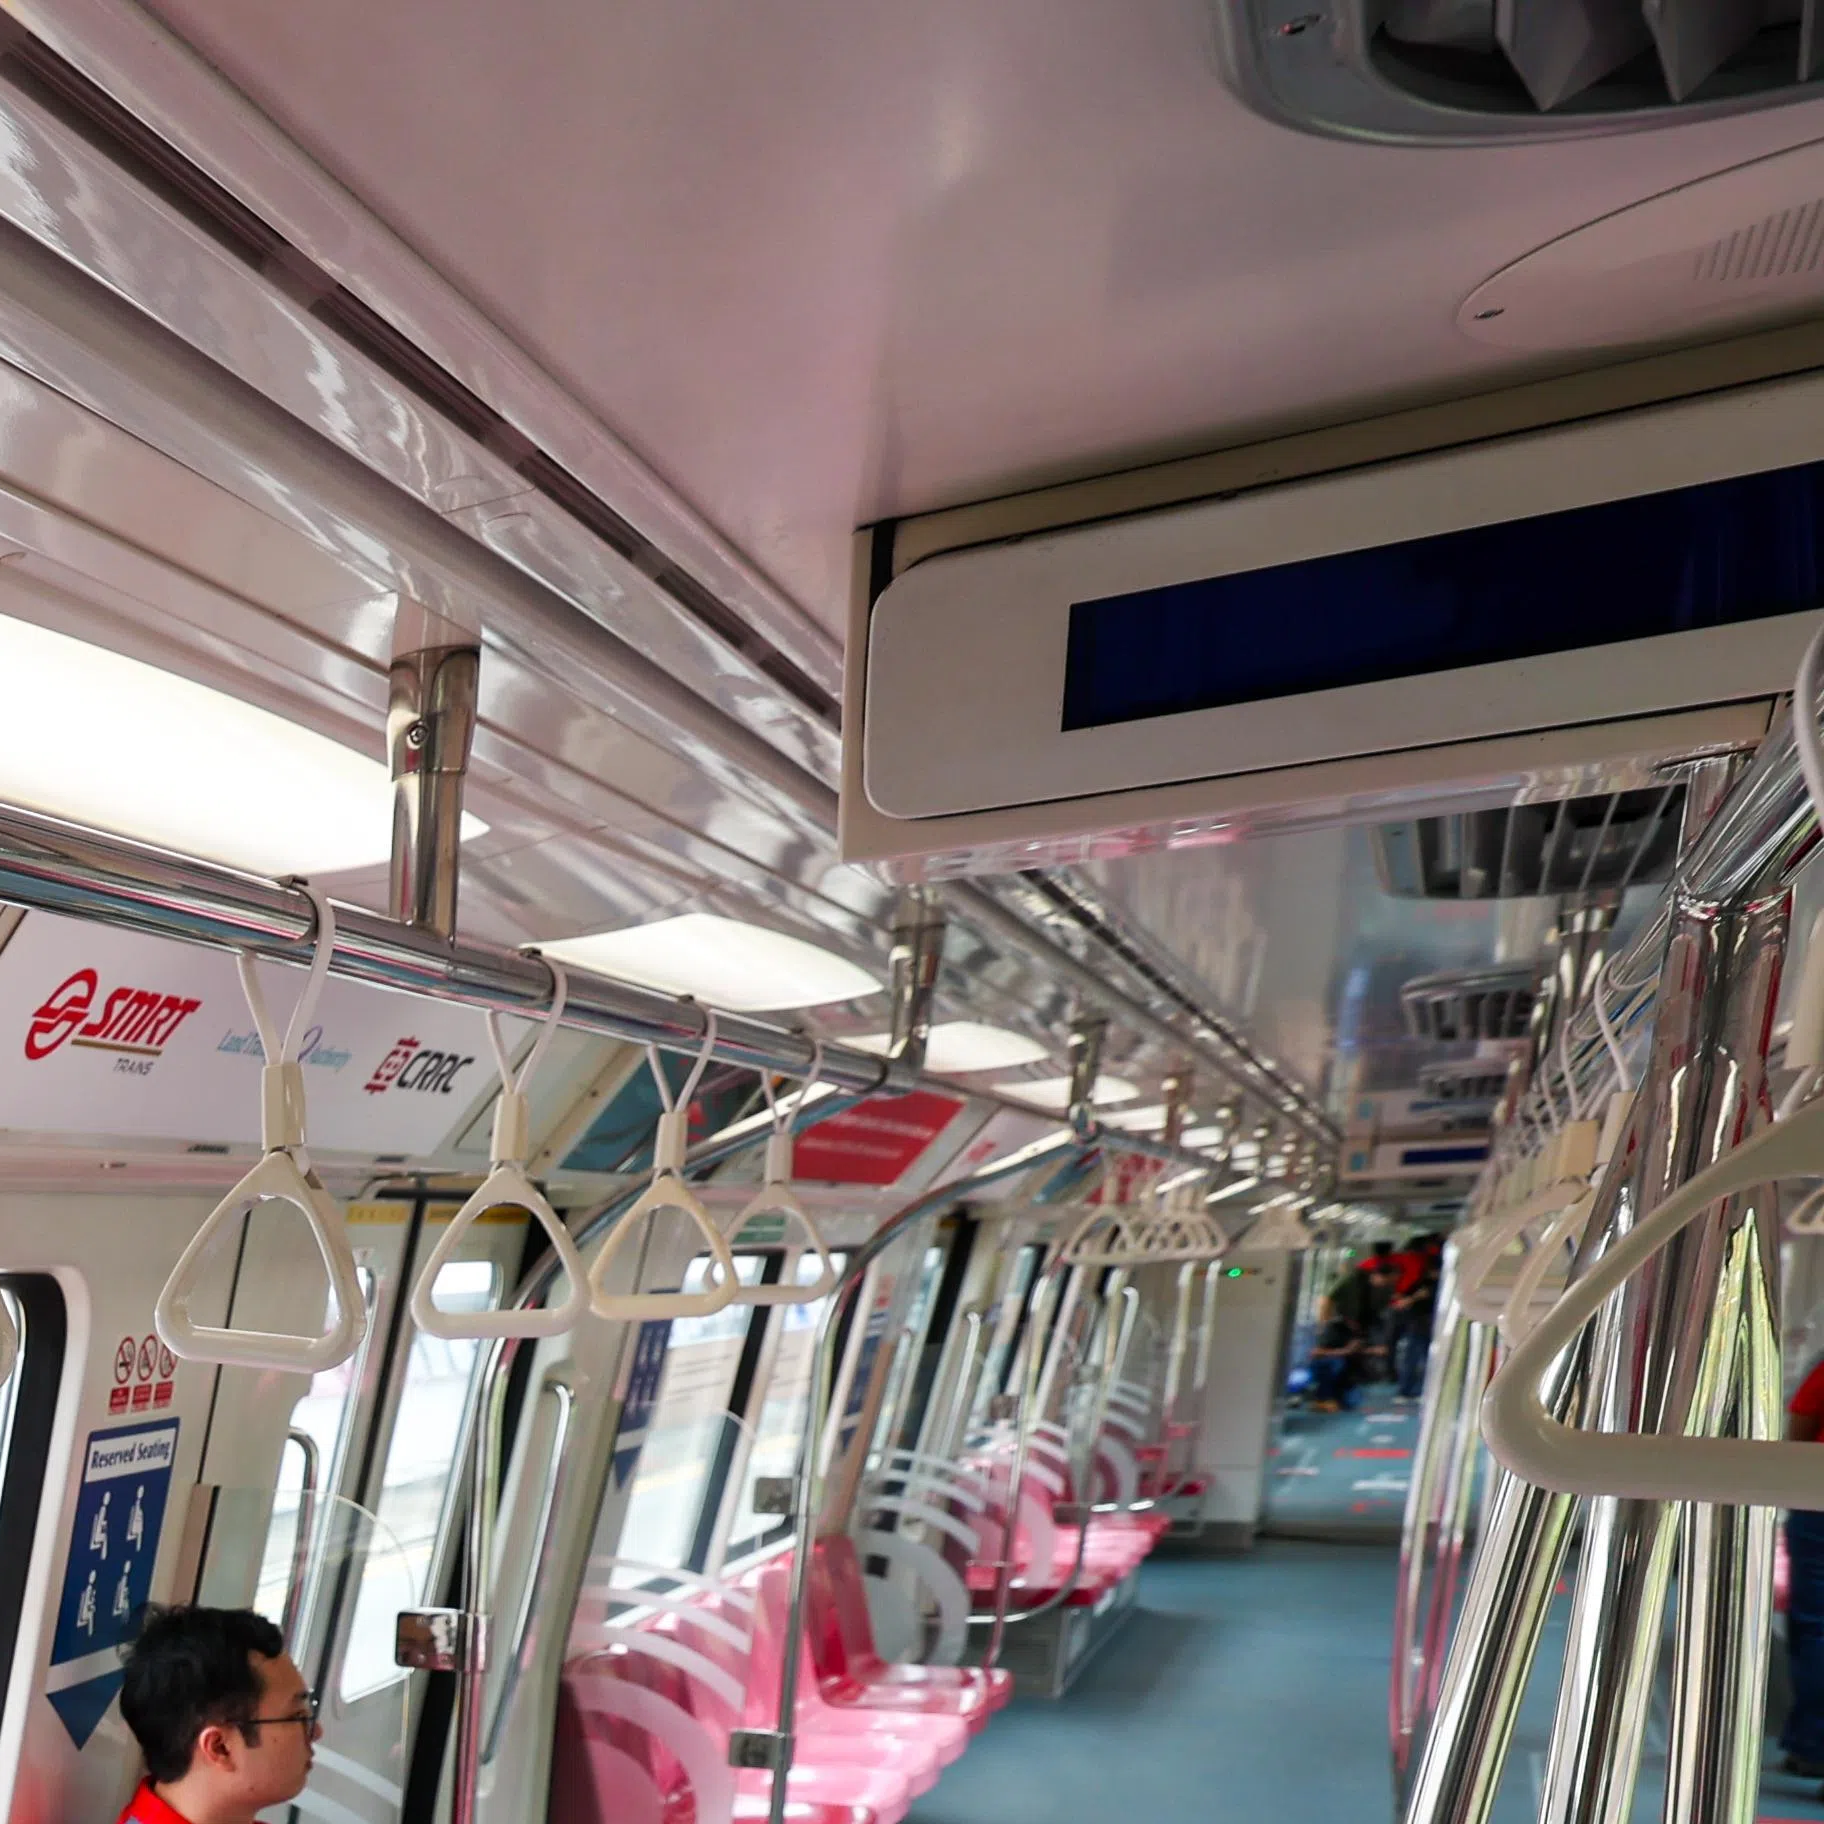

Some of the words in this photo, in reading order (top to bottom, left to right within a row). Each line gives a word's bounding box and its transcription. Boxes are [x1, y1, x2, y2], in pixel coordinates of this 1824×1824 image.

[78, 986, 203, 1046] SMRT
[396, 1048, 475, 1094] CRRC
[91, 1441, 136, 1469] Reserved
[138, 1438, 170, 1462] Seating
